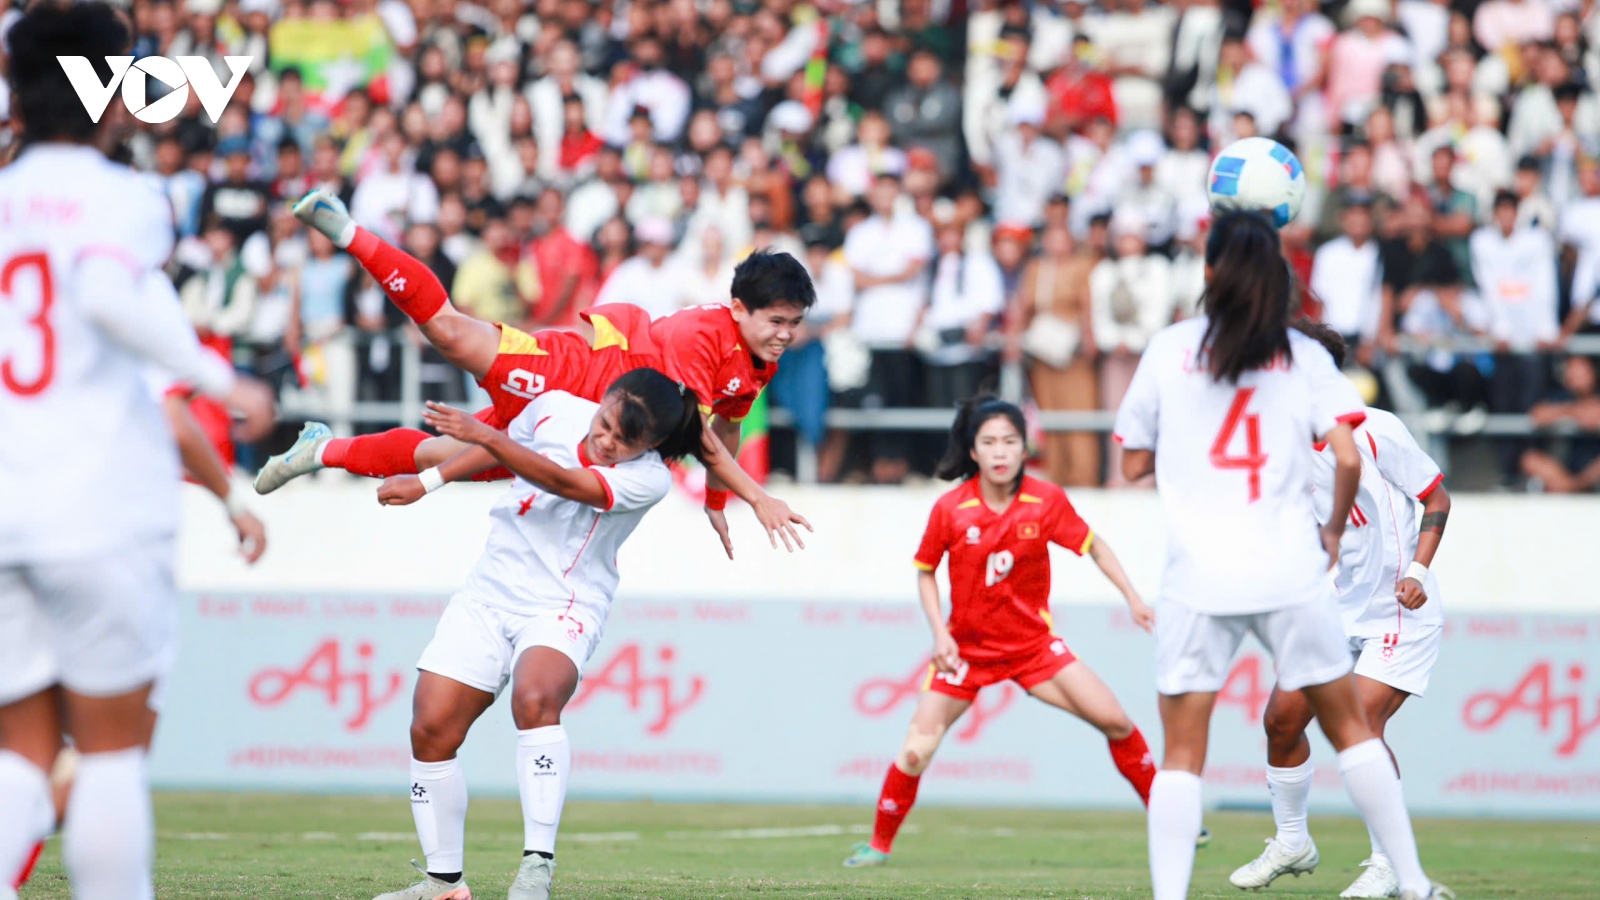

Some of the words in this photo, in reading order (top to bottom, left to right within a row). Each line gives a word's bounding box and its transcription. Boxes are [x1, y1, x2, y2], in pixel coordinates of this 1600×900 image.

[0, 253, 54, 396] 3
[1209, 386, 1267, 502] 4
[985, 550, 1014, 587] 19
